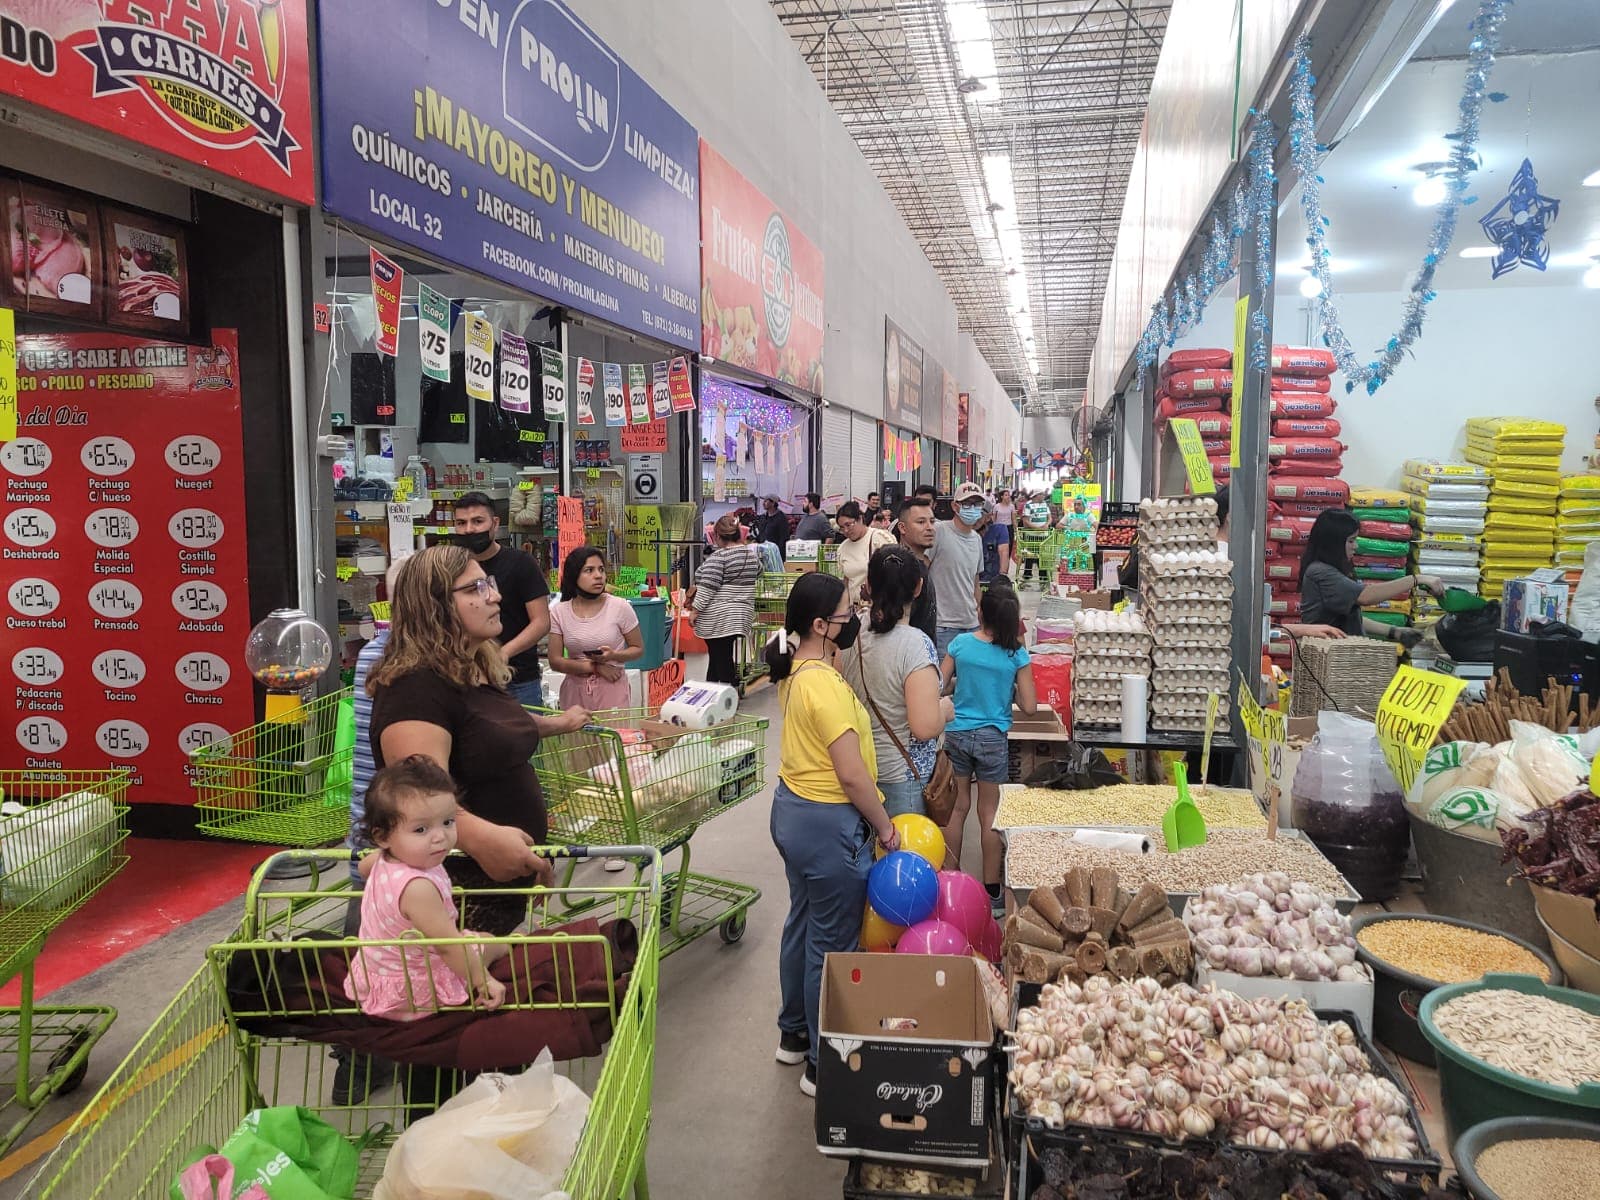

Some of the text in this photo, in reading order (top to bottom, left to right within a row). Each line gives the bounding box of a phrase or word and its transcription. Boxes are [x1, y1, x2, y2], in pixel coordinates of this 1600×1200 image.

[460, 0, 499, 49] EN
[131, 32, 257, 116] CARNES
[150, 79, 245, 129] LA CARNE QUE RINDE
[169, 93, 183, 113] QUE
[183, 97, 191, 116] SI
[208, 109, 214, 126] A
[214, 113, 235, 132] CARNE
[624, 122, 696, 201] LIMPIEZA!
[414, 85, 665, 267] ¡MAYOREO Y MENUDEO!
[352, 123, 697, 315] QUÍMICOS JARCERÍA MATERIAS PRIMAS ALBERCAS
[369, 188, 443, 241] LOCAL 32
[711, 204, 758, 286] Frutas
[482, 240, 620, 313] FACEBOOK.COM/PROLINLAGUNA
[315, 309, 328, 326] 32
[423, 303, 445, 321] CLORO
[641, 309, 655, 327] TEL:
[421, 329, 446, 356] $75
[24, 349, 56, 372] QUE
[56, 349, 73, 369] SI
[77, 348, 118, 369] SABE
[120, 348, 133, 368] A
[134, 346, 188, 368] CARNE
[466, 354, 492, 378] $120
[48, 375, 85, 391] POLLO
[97, 373, 154, 391] PESCADO
[26, 404, 89, 426] del Dia
[88, 443, 118, 467] $65
[172, 442, 202, 466] $62
[7, 478, 49, 492] Pechuga
[88, 478, 131, 492] Pechuga
[175, 478, 213, 490] Nueget
[962, 485, 980, 494] FILA
[6, 491, 52, 505] Mariposa
[101, 491, 132, 502] hueso
[11, 515, 39, 538] $125
[92, 516, 120, 538] $78
[624, 509, 656, 526] No se
[176, 516, 205, 540] $83
[3, 549, 60, 561] Deshebrada
[95, 550, 131, 561] Molida
[178, 550, 217, 562] Costilla
[93, 563, 135, 575] Especial
[180, 564, 216, 576] Simple
[179, 588, 209, 611] $92
[6, 617, 67, 630] Queso trebol
[94, 618, 140, 631] Prensado
[178, 620, 225, 632] Adobada
[19, 654, 46, 677] $33
[99, 657, 128, 680] $115
[15, 687, 63, 700] Pedaceria
[104, 689, 137, 703] Tocino
[184, 692, 224, 705] Chorizo
[27, 700, 65, 712] discada
[23, 722, 52, 746] $87
[103, 727, 132, 750] $85
[25, 757, 63, 769] Chuleta
